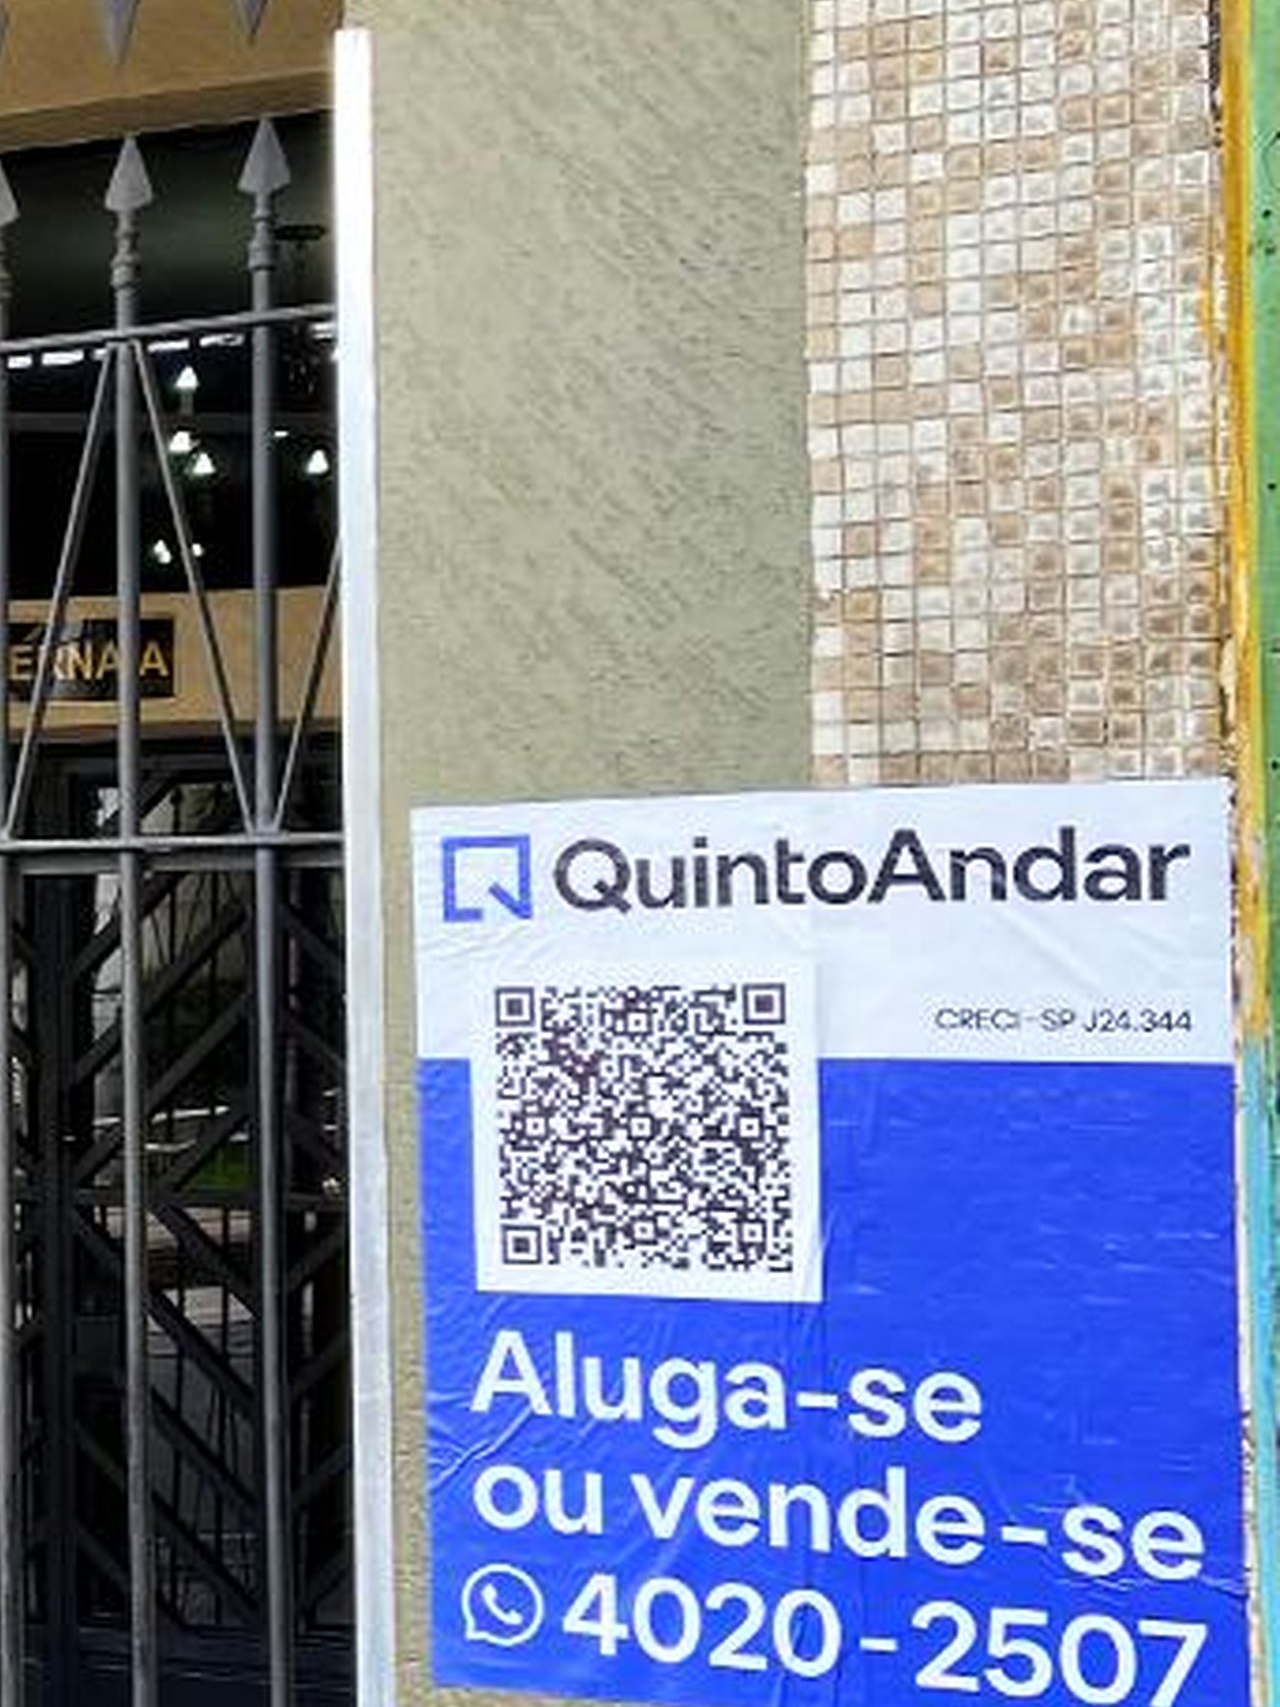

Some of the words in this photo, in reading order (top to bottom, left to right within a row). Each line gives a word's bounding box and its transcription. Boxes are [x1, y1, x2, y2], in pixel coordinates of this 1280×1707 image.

[553, 826, 1191, 915] QuintoAndar
[1081, 1008, 1192, 1033] J24.344
[471, 1330, 983, 1449] Aluga-se
[473, 1464, 604, 1536] ou
[632, 1467, 1206, 1582] vende-se
